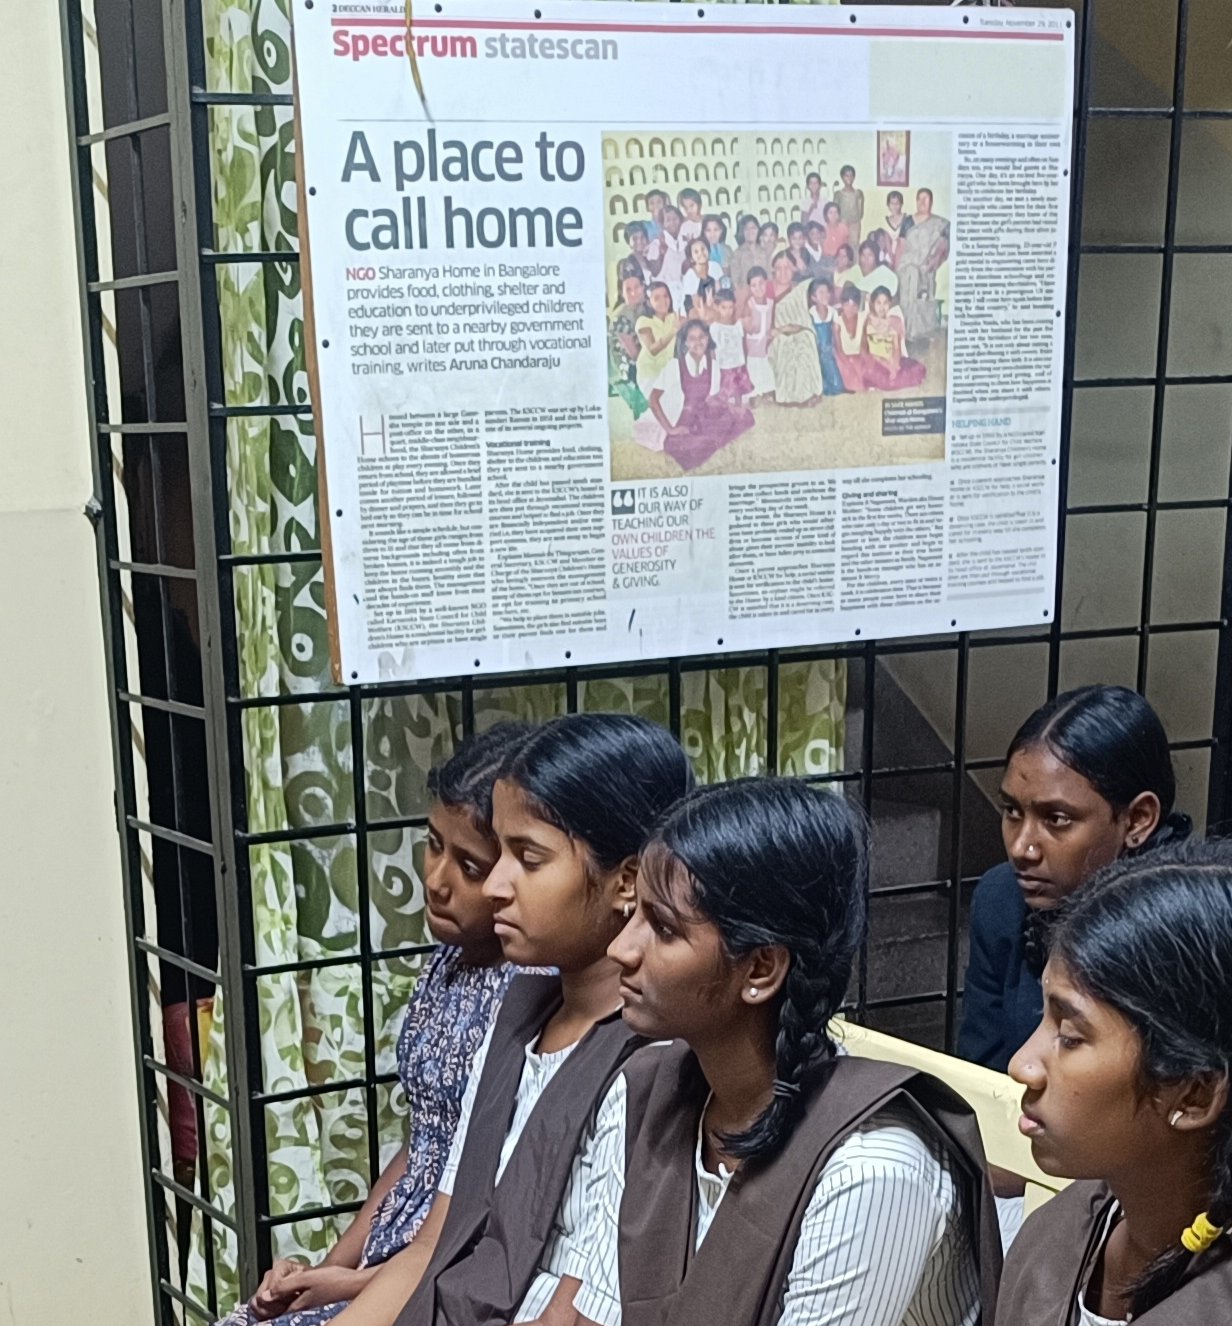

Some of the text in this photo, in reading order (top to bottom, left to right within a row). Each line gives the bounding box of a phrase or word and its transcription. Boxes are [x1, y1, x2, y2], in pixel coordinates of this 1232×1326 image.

[338, 4, 372, 13] DECCAN
[1006, 19, 1035, 27] November
[485, 33, 618, 60] statescan
[341, 128, 585, 191] A place to
[345, 196, 583, 251] call home
[346, 263, 560, 281] NGO Sharanya Home in Bangalore
[347, 281, 565, 301] provides food, clothing, shelter and
[348, 303, 412, 319] education
[415, 305, 428, 317] to
[431, 300, 529, 318] underprivileged
[350, 318, 584, 340] they are sent to a nearby government
[351, 335, 591, 356] school and later put through vocational
[352, 356, 561, 376] training, writes Aruna Chandaraju
[638, 485, 688, 498] IT IS ALSO
[638, 499, 703, 514] OUR WAY OF
[612, 515, 688, 530] TEACHING OUR
[612, 527, 715, 545] OWN CHILDREN THE
[612, 545, 669, 559] VALUES OF
[612, 559, 676, 574] GENEROSITY
[612, 577, 620, 589] &
